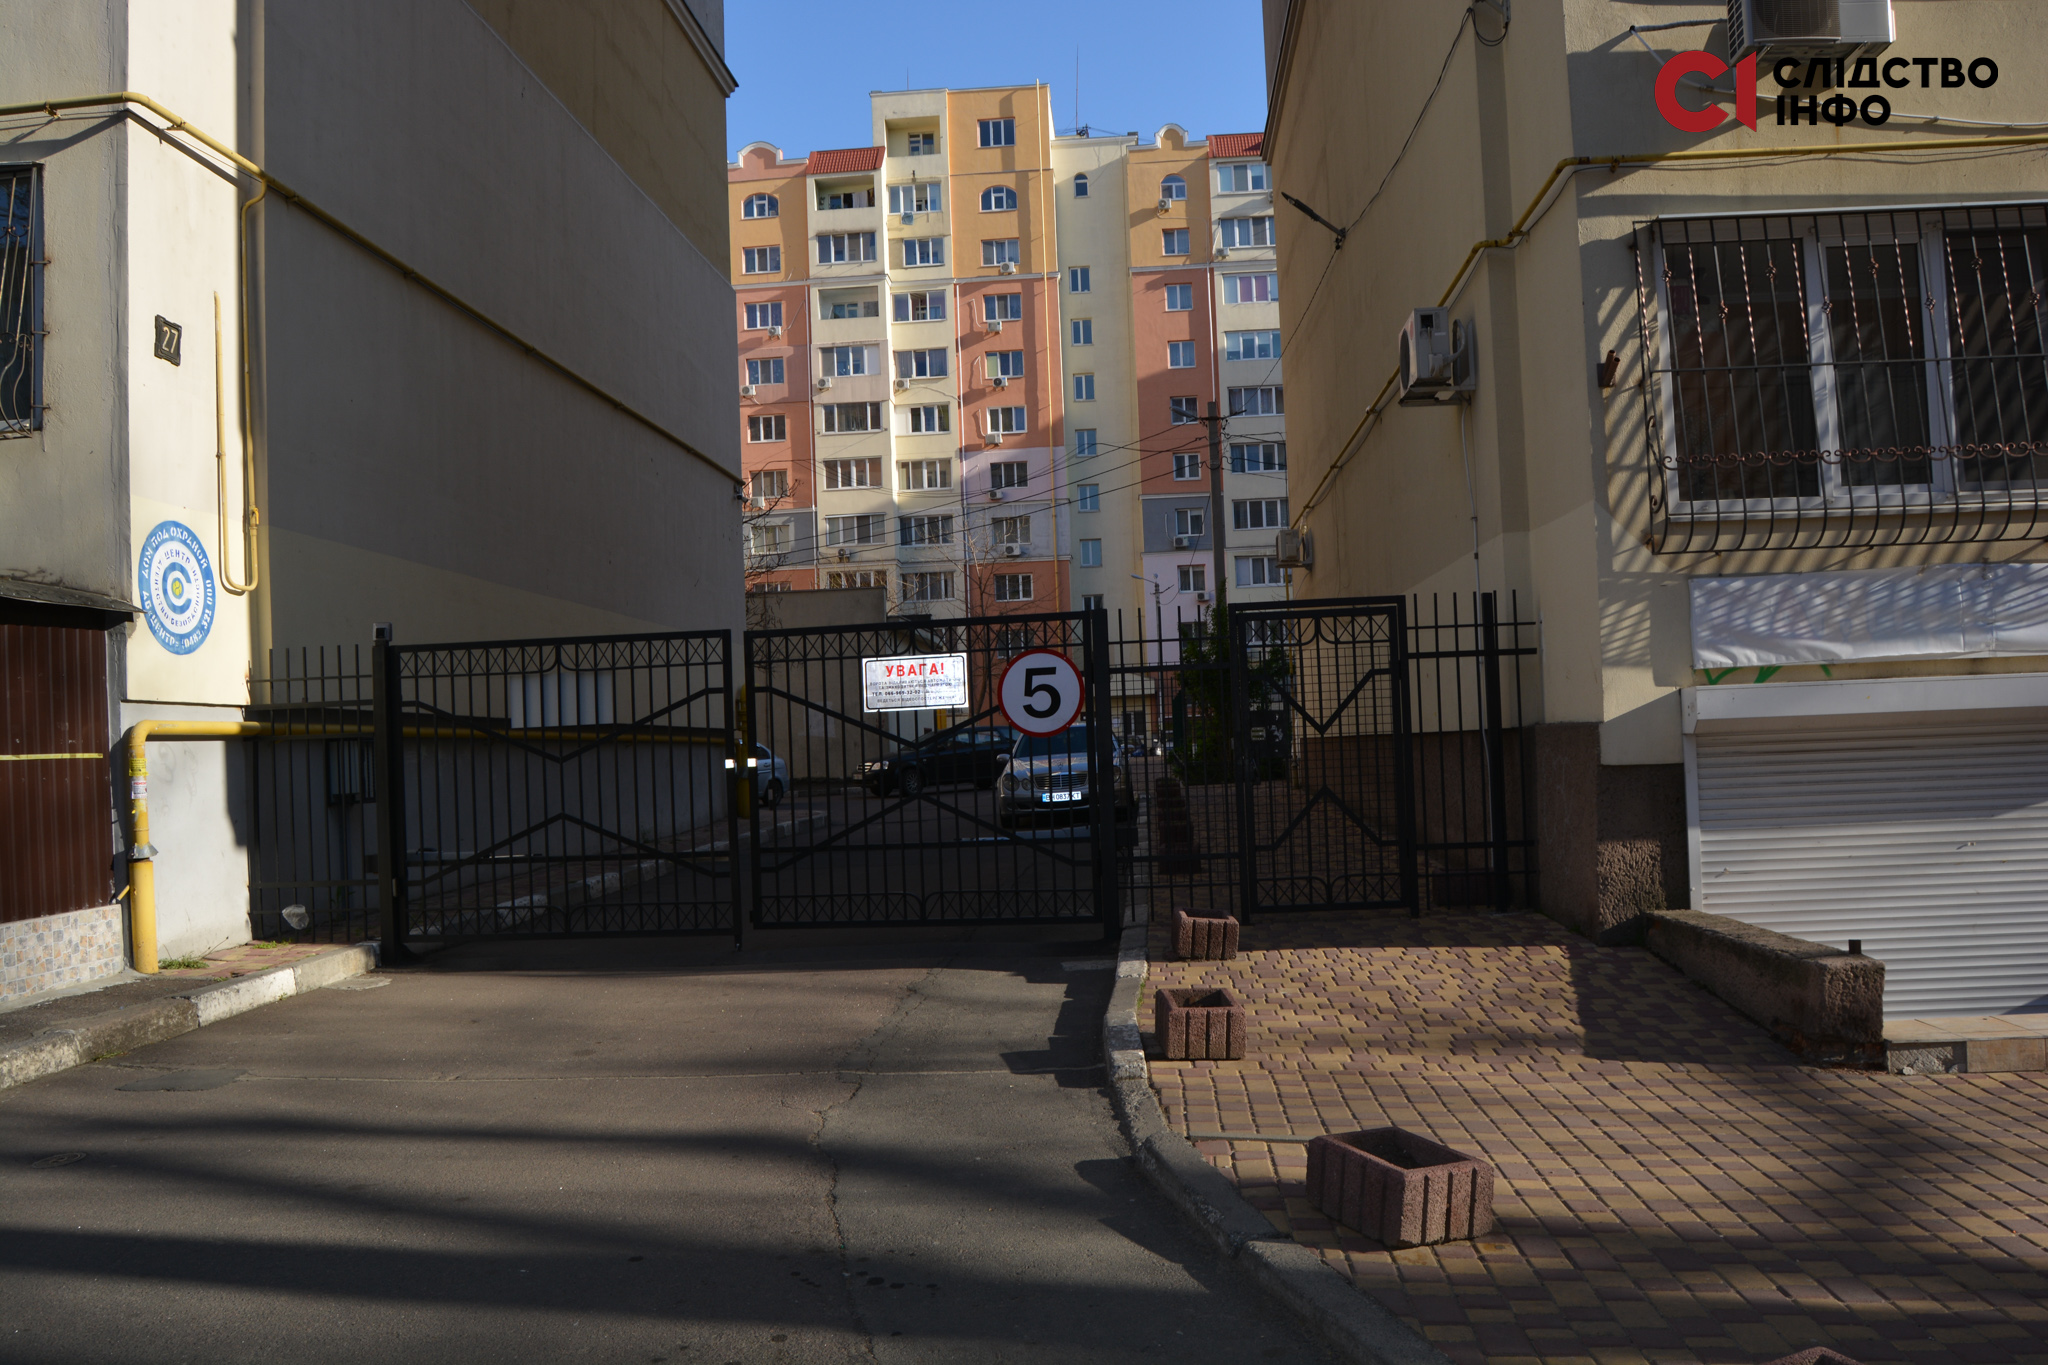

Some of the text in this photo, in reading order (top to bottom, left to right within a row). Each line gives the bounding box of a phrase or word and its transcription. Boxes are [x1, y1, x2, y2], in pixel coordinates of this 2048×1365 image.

[162, 326, 179, 354] 27
[142, 526, 208, 579] ДОМ ПОД ОХРАНОЙ
[164, 548, 190, 564] ЦЕНТР
[886, 662, 944, 678] УВАГА!
[1022, 666, 1062, 718] 5
